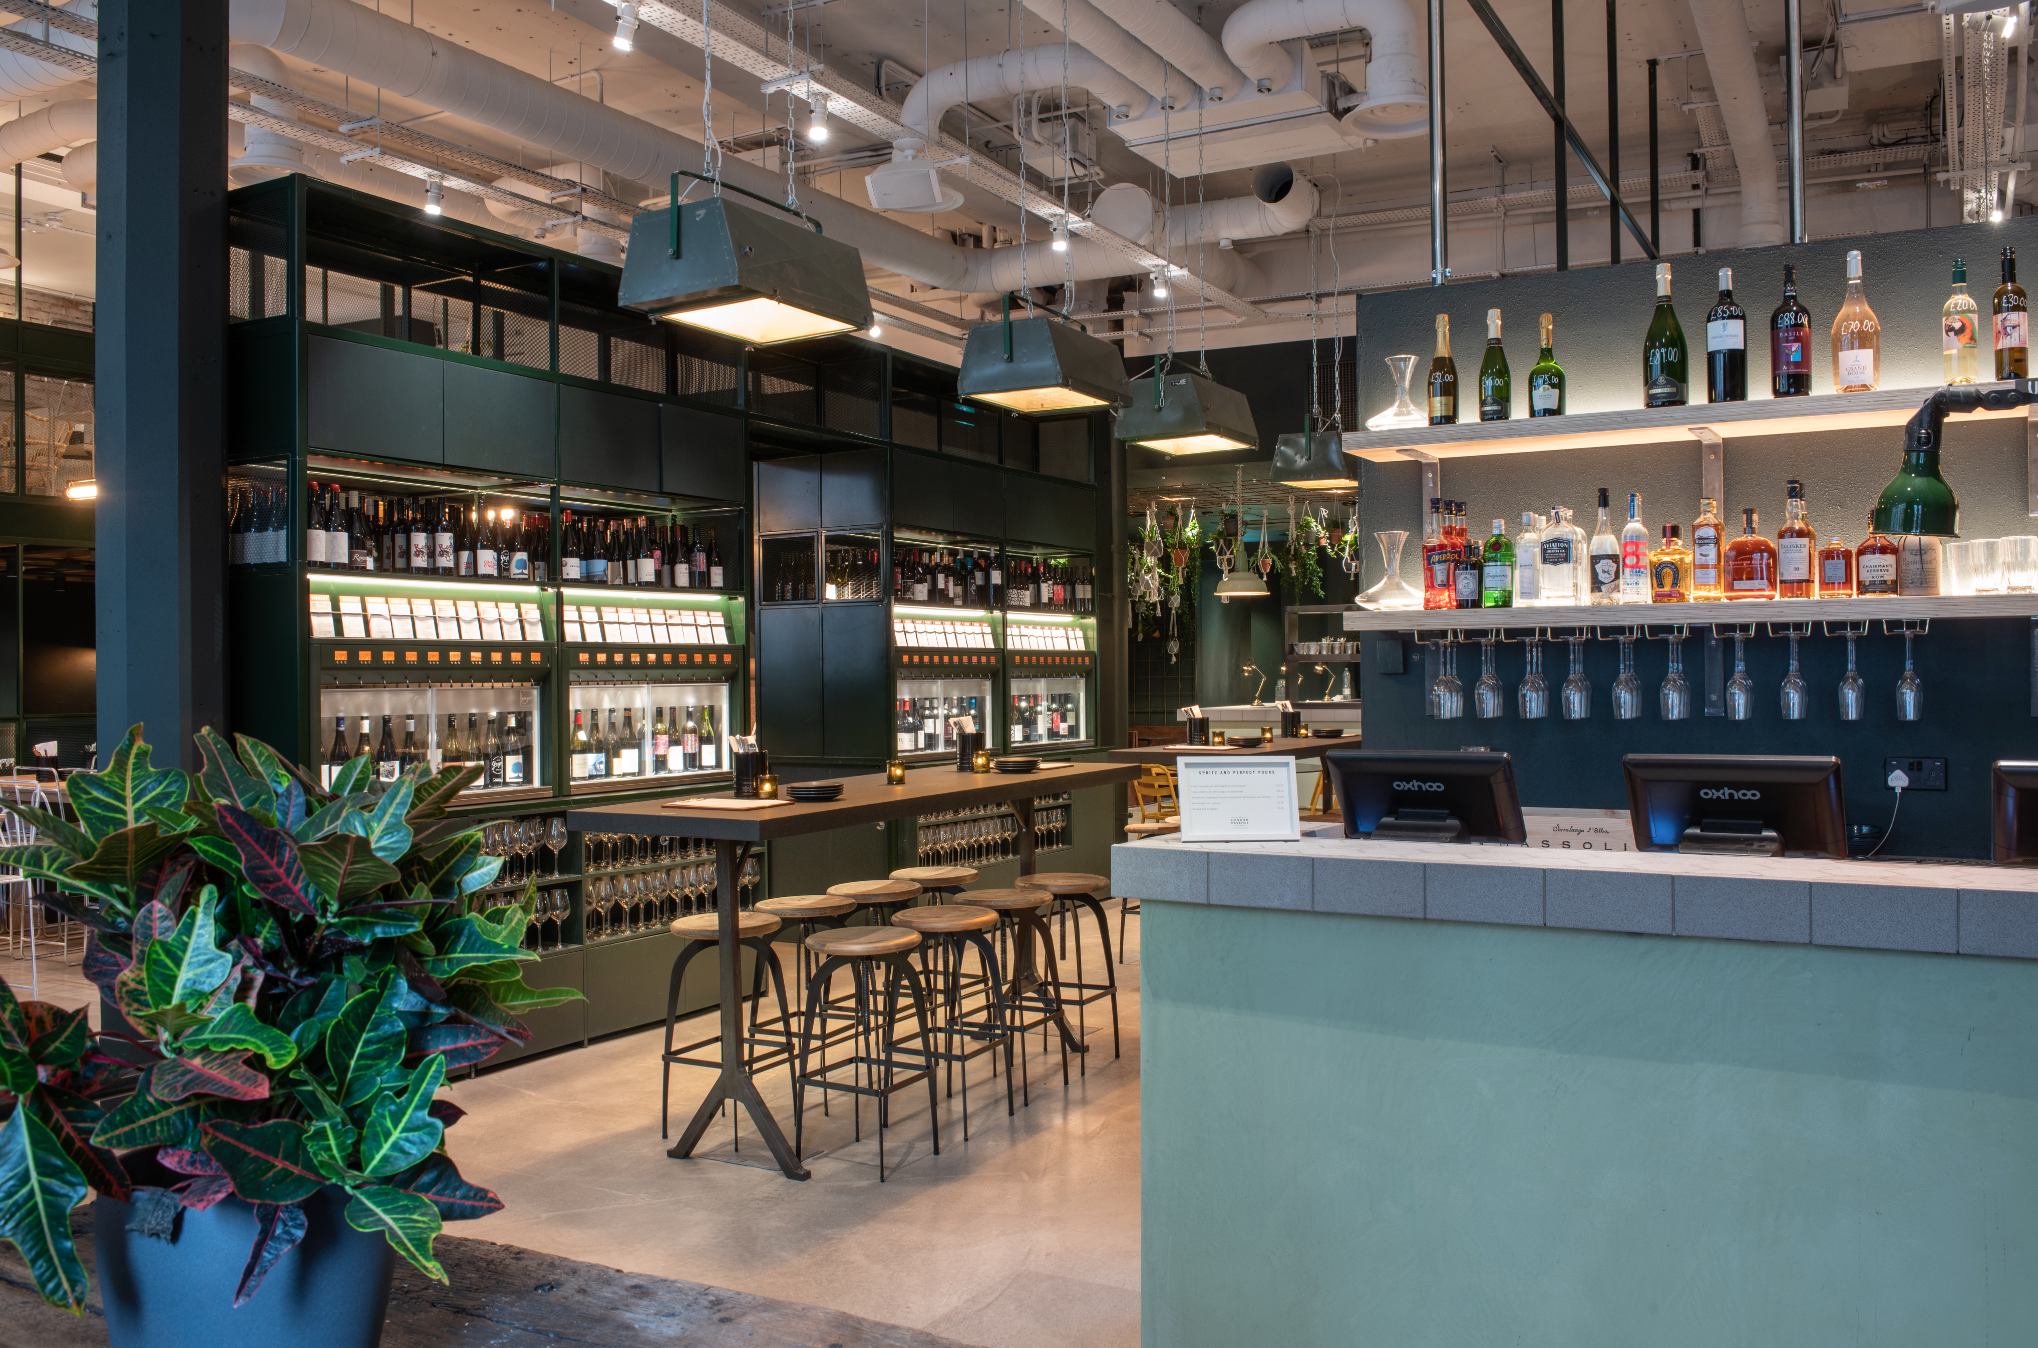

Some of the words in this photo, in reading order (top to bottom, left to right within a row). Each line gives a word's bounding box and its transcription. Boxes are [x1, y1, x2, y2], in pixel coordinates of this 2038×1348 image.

[1710, 304, 1744, 321] £85.00
[1777, 311, 1808, 328] £88.00
[1841, 319, 1876, 335] £70.00
[1649, 346, 1679, 365] £89.00
[1543, 541, 1568, 549] AVIATION
[1392, 779, 1445, 792] oxhoo
[1699, 786, 1761, 800] oxhoo
